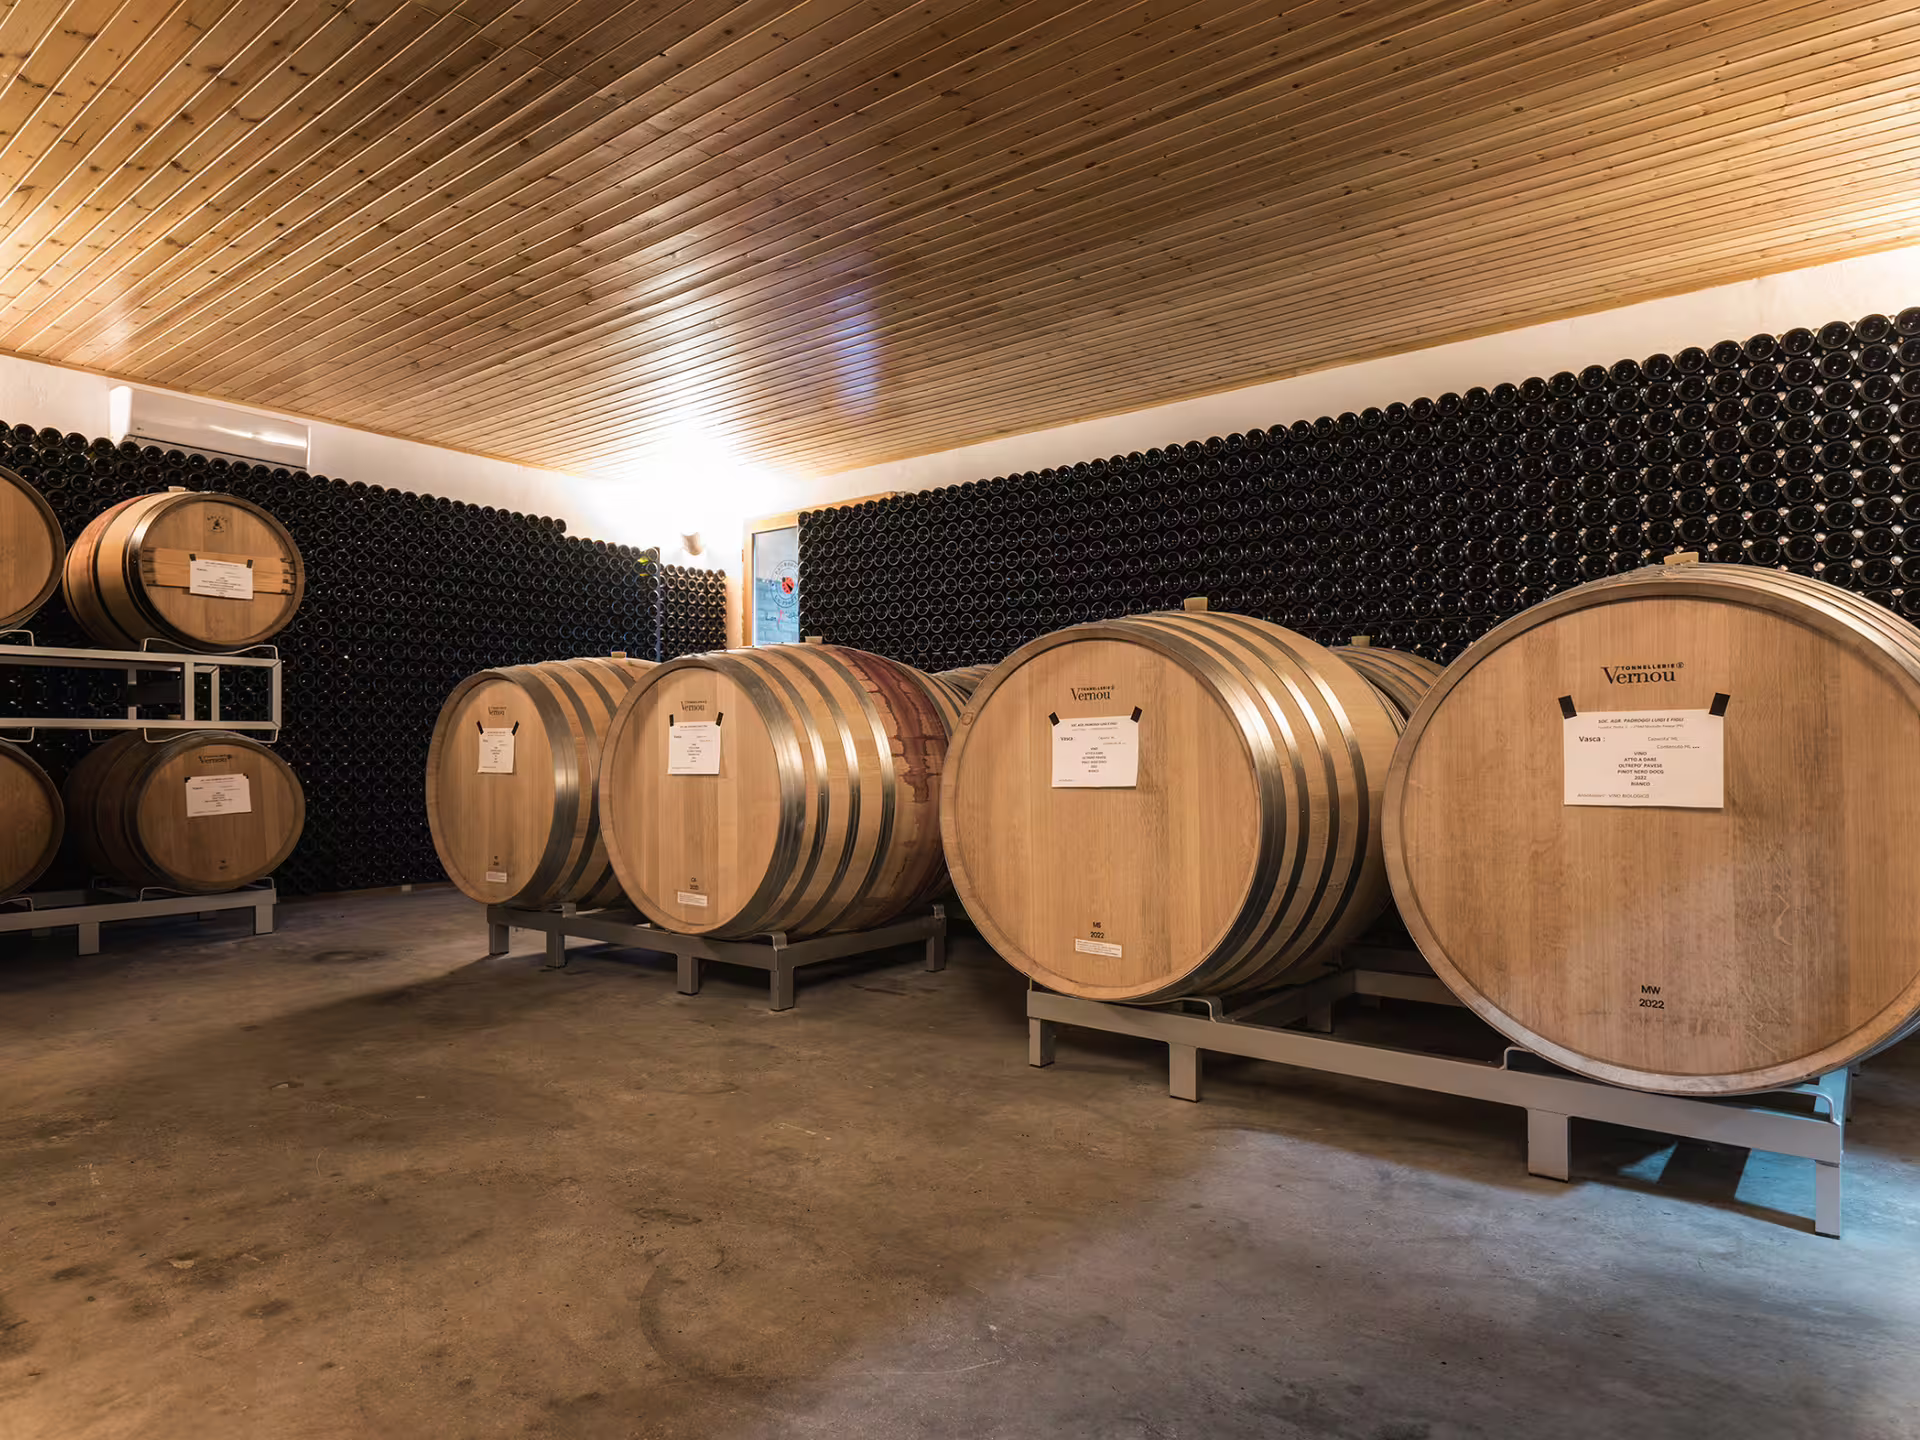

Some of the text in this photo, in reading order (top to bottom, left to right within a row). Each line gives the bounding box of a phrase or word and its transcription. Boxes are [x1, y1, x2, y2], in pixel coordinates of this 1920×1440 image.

[1601, 666, 1676, 684] Vernou
[1070, 687, 1111, 702] Vernou
[1090, 931, 1105, 939] 2022
[1641, 985, 1661, 995] MW
[1639, 998, 1665, 1010] 2022
